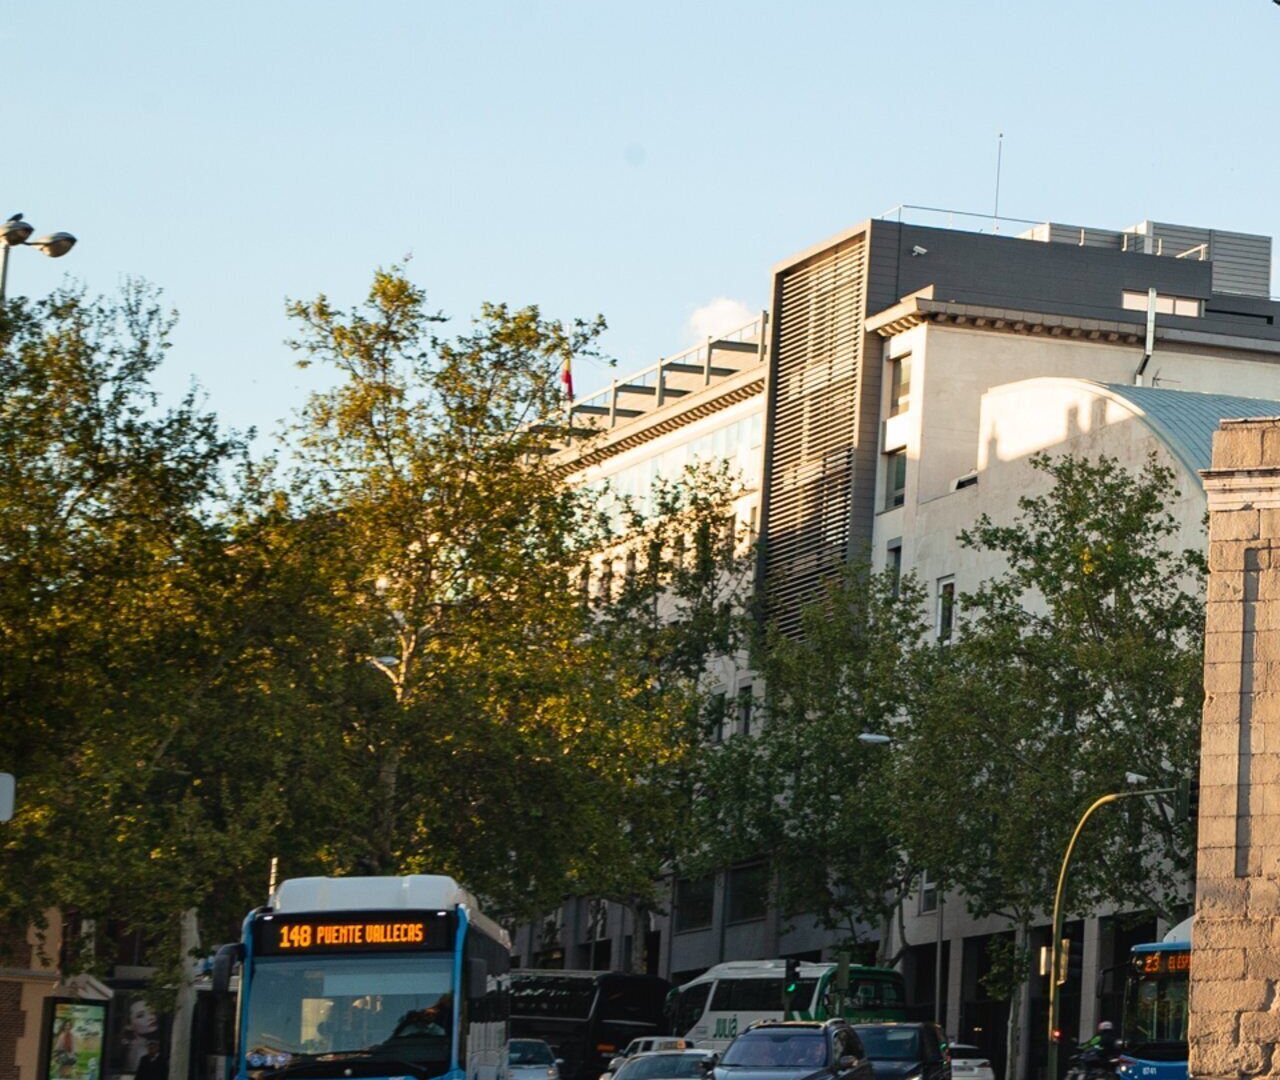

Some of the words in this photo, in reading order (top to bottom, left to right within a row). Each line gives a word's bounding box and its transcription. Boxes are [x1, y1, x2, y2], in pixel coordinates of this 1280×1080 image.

[280, 925, 312, 948] 148
[316, 925, 363, 945] PUENTE
[365, 923, 424, 943] VALLECAS
[1144, 954, 1160, 972] 23
